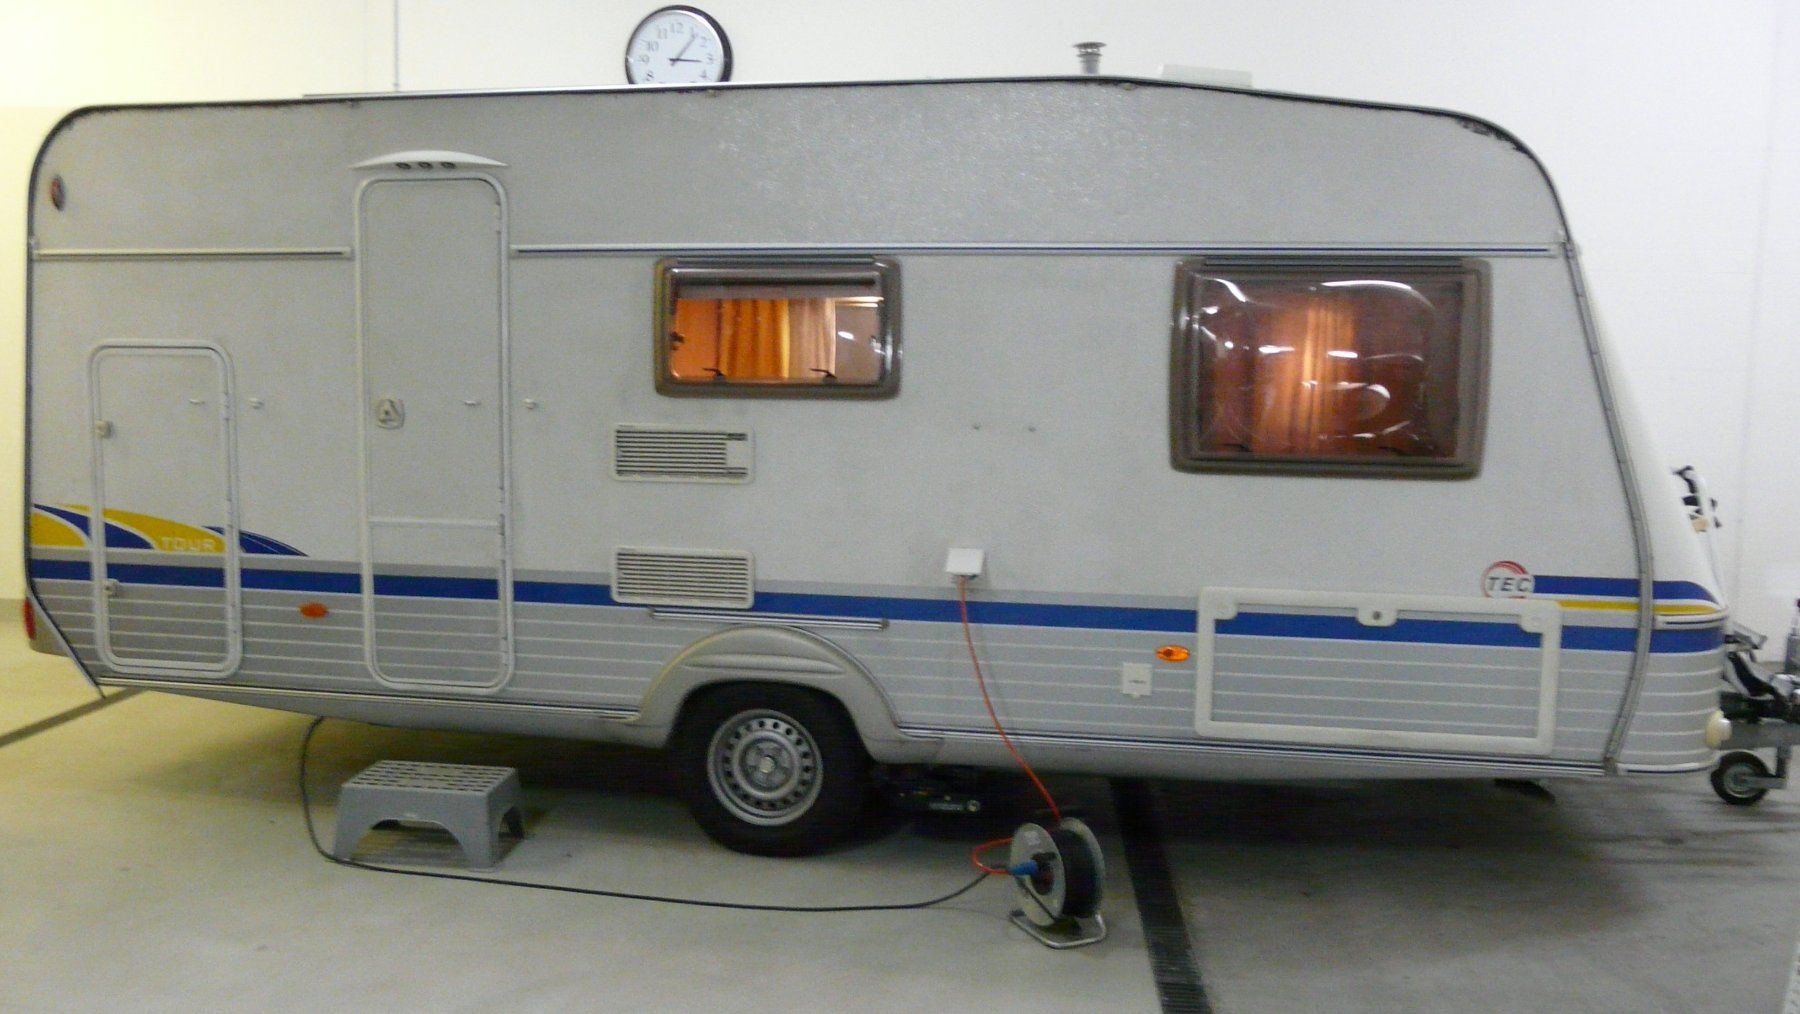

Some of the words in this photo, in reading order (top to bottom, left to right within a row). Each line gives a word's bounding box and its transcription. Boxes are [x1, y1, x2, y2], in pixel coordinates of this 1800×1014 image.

[657, 28, 668, 40] 11
[669, 22, 684, 34] 12
[646, 40, 659, 52] 10
[161, 536, 215, 553] TOUR
[1488, 576, 1531, 592] TEC
